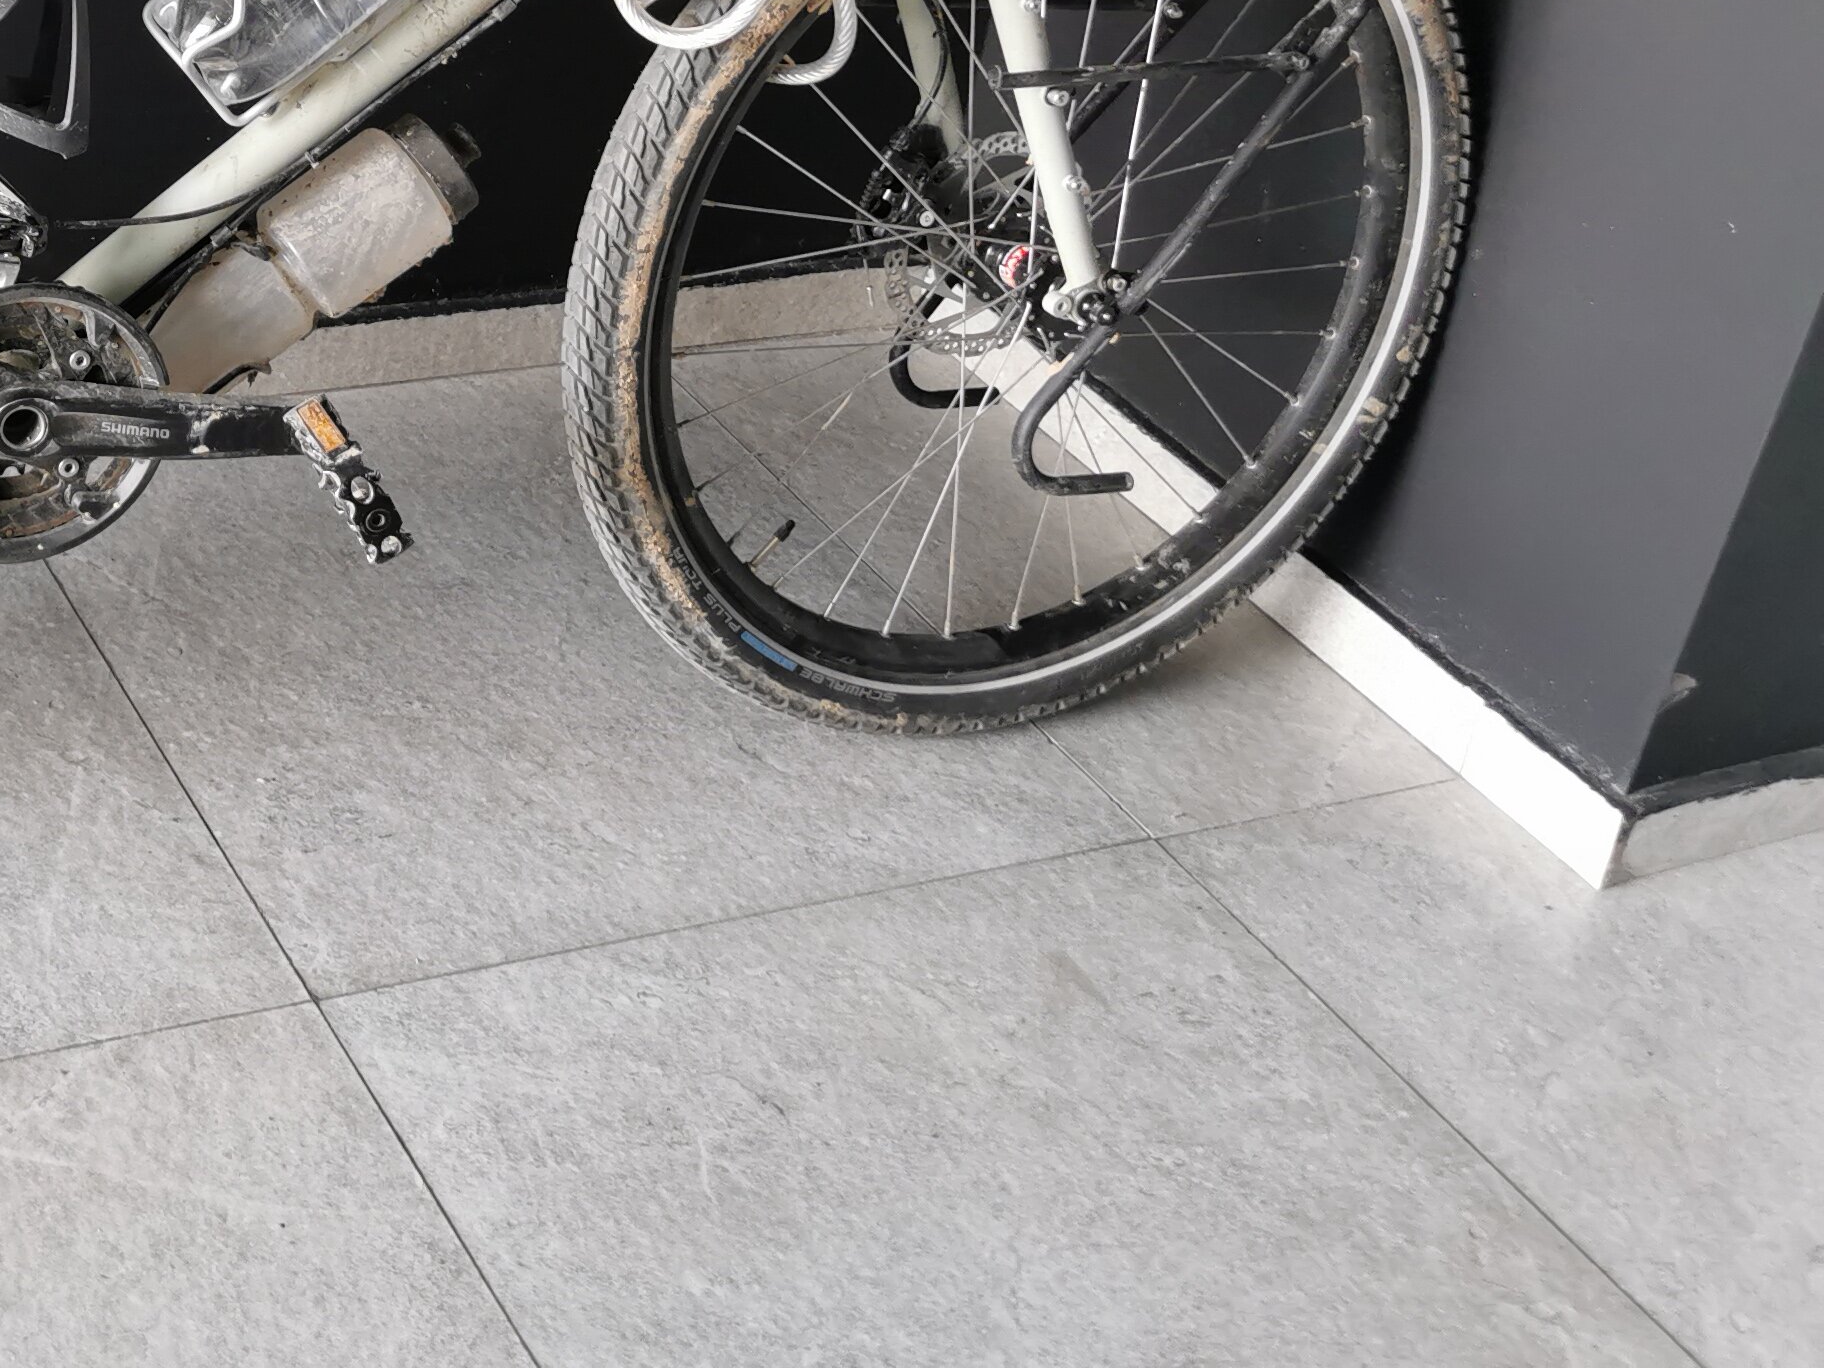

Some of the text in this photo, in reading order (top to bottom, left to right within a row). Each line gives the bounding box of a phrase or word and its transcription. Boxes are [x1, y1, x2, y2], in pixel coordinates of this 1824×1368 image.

[100, 421, 170, 439] SHIMANO
[670, 546, 897, 703] SCHWALBE PLUS TOUR
